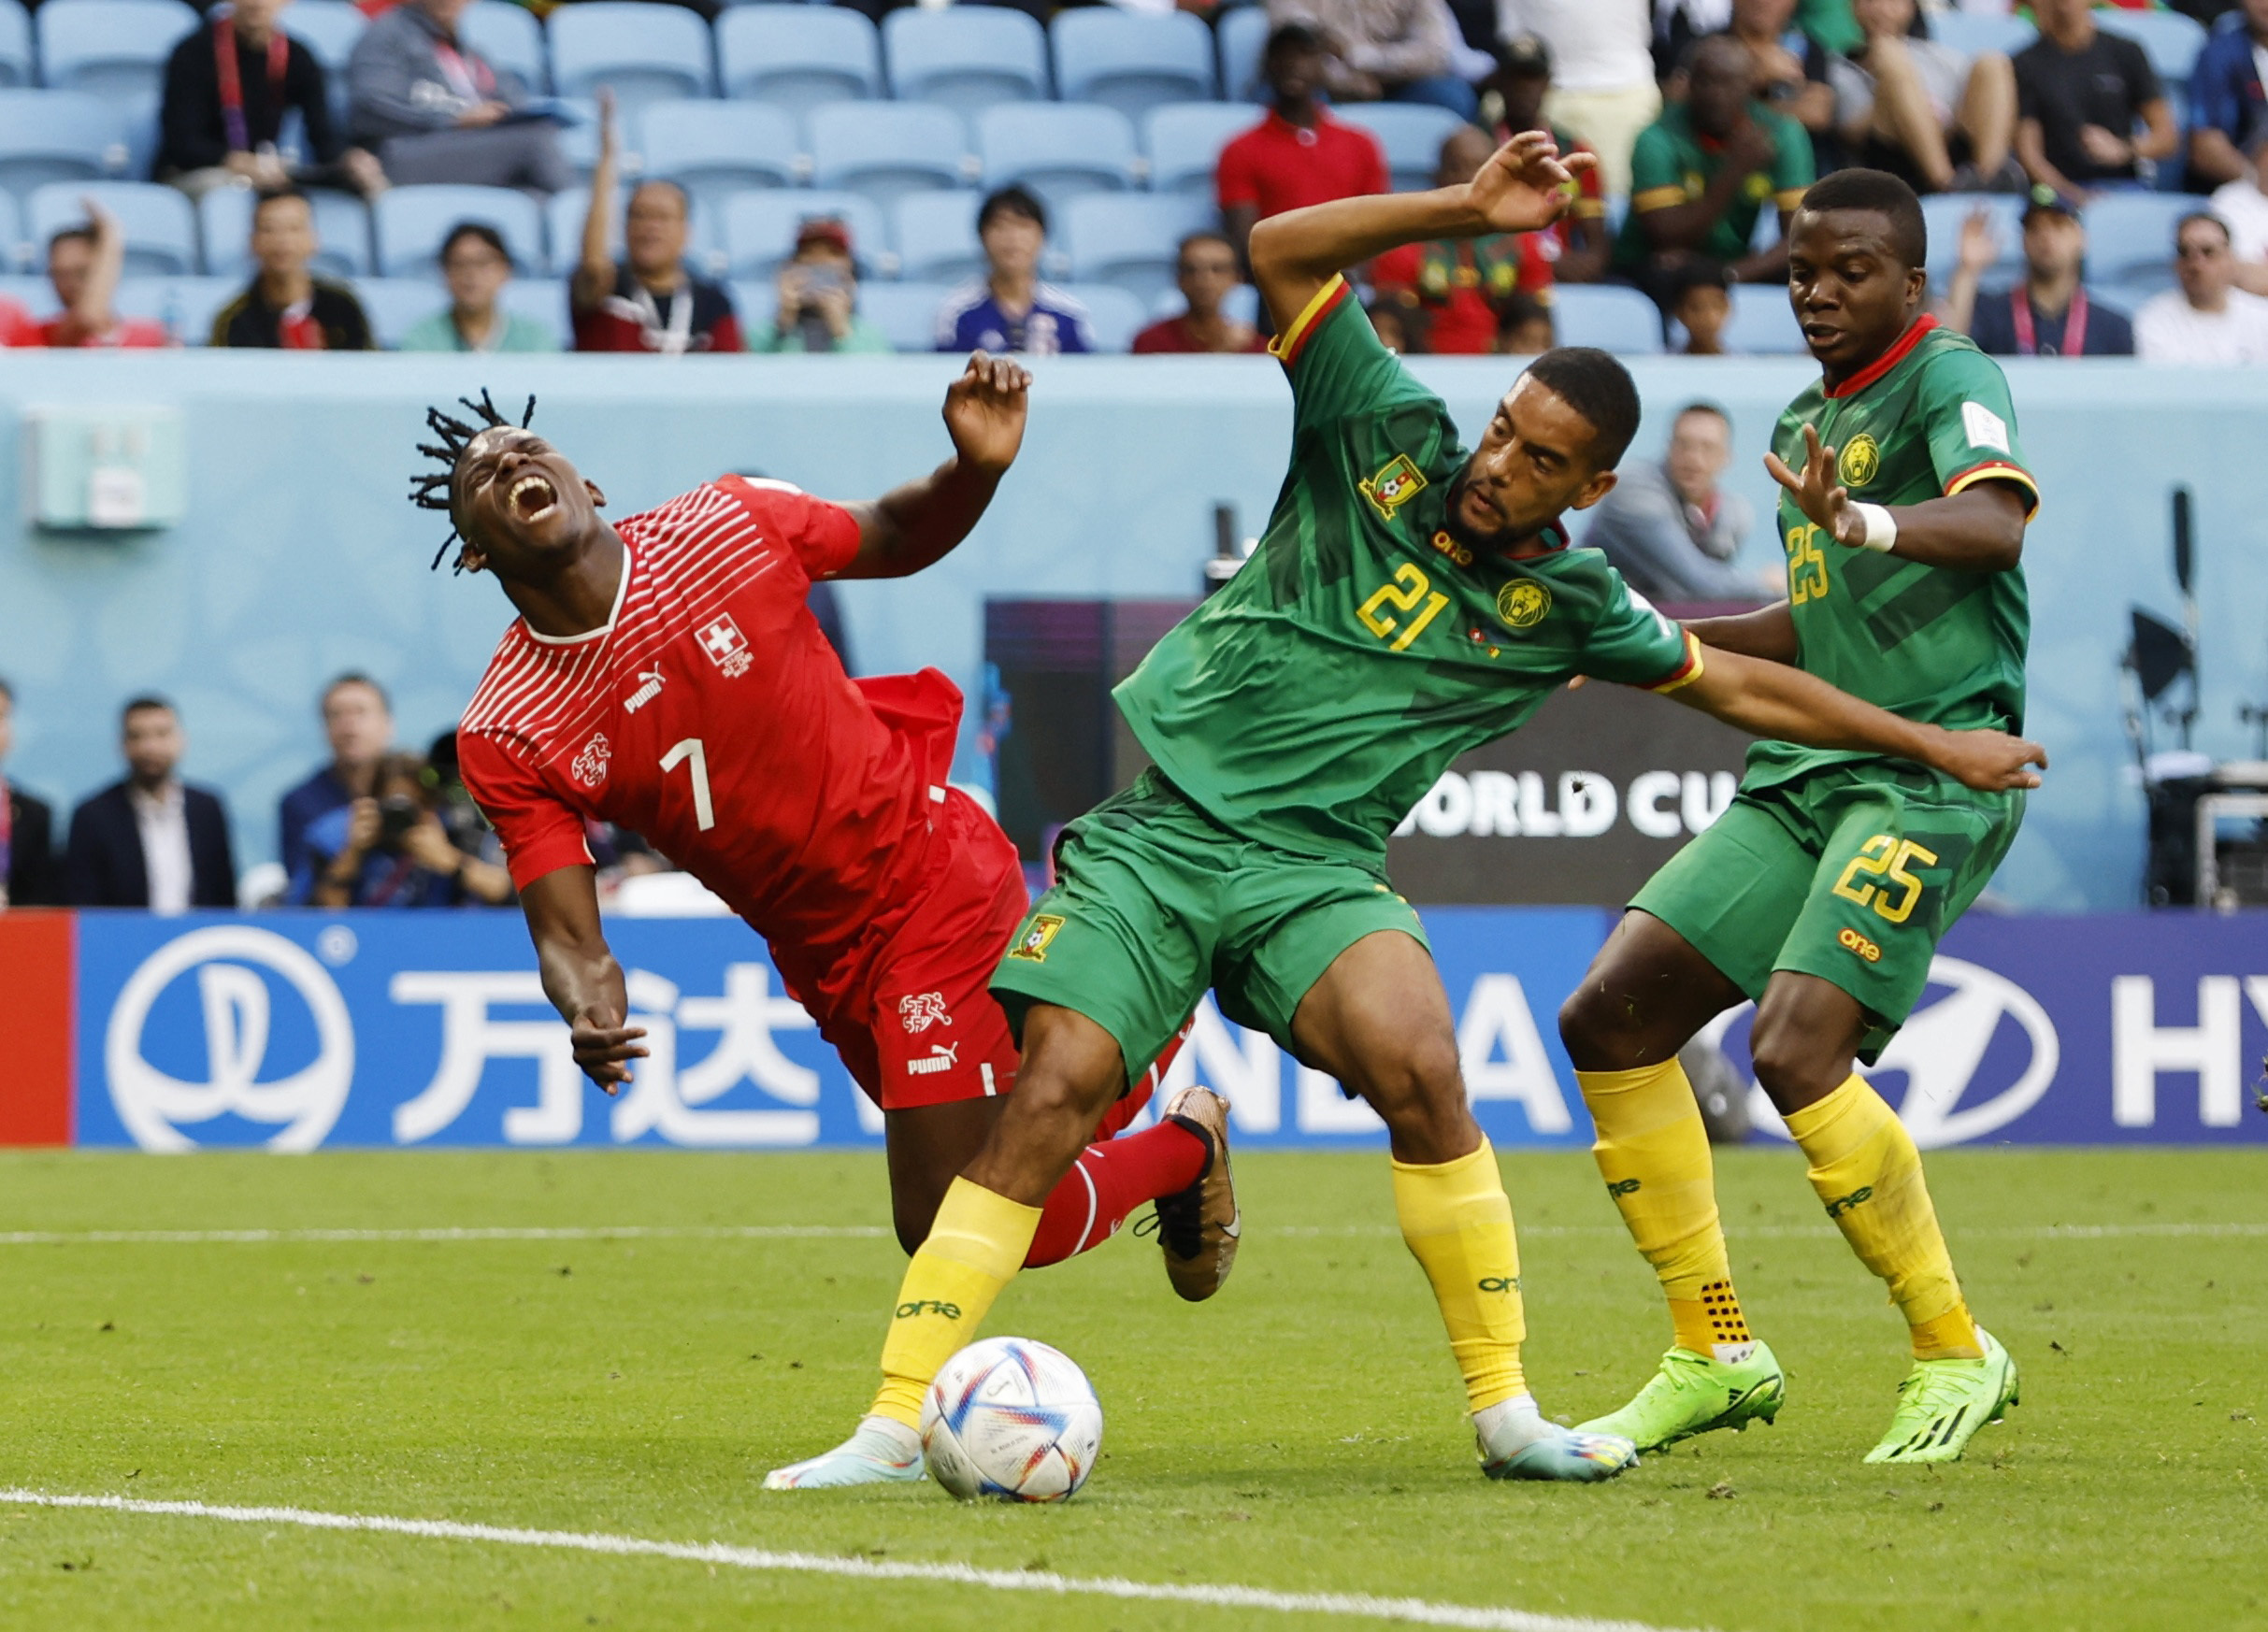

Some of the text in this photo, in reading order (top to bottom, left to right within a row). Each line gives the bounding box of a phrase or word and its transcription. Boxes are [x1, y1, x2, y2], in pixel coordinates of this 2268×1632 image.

[1433, 530, 1473, 565] one
[1787, 522, 1830, 606] 25
[1356, 563, 1450, 651] 21
[624, 680, 662, 714] PUMA
[659, 737, 715, 832] 7
[1832, 835, 1938, 923] 25
[1839, 929, 1880, 961] one
[390, 963, 820, 1146] 万达
[907, 1055, 952, 1076] PUMA
[1607, 1179, 1641, 1200] ne
[897, 1300, 961, 1320] one
